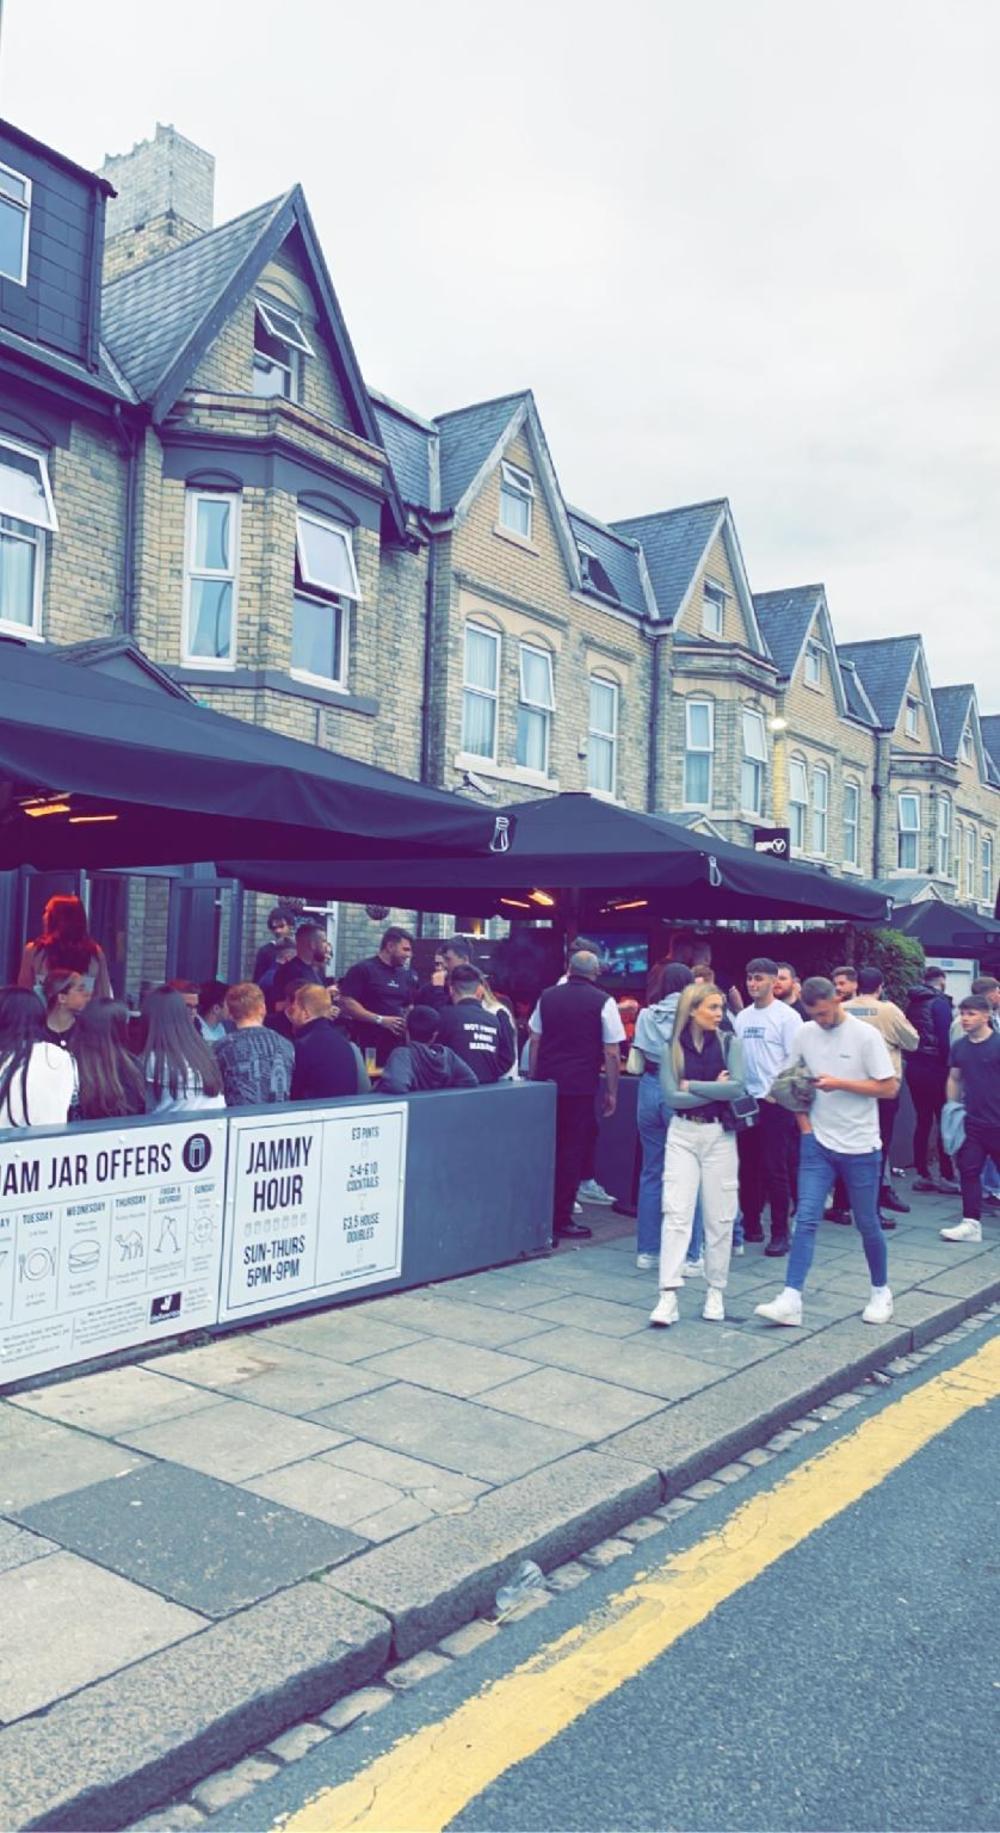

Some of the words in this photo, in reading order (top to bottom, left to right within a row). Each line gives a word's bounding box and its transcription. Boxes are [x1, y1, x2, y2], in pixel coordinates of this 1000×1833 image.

[246, 1136, 314, 1175] JAMMY
[0, 1160, 40, 1197] AM
[48, 1154, 88, 1190] JAR
[96, 1142, 172, 1182] OFFERS
[346, 1174, 380, 1193] COCKTAILS
[115, 1195, 146, 1209] THURSDAY
[253, 1174, 304, 1213] HOUR
[22, 1211, 53, 1225] TUESDAY
[66, 1202, 106, 1217] WEDNESDAY
[360, 1212, 380, 1228] HOUSE
[346, 1226, 374, 1244] DOUBLES
[244, 1235, 306, 1265] SUN-THURS
[246, 1258, 300, 1288] 5PM-9PM
